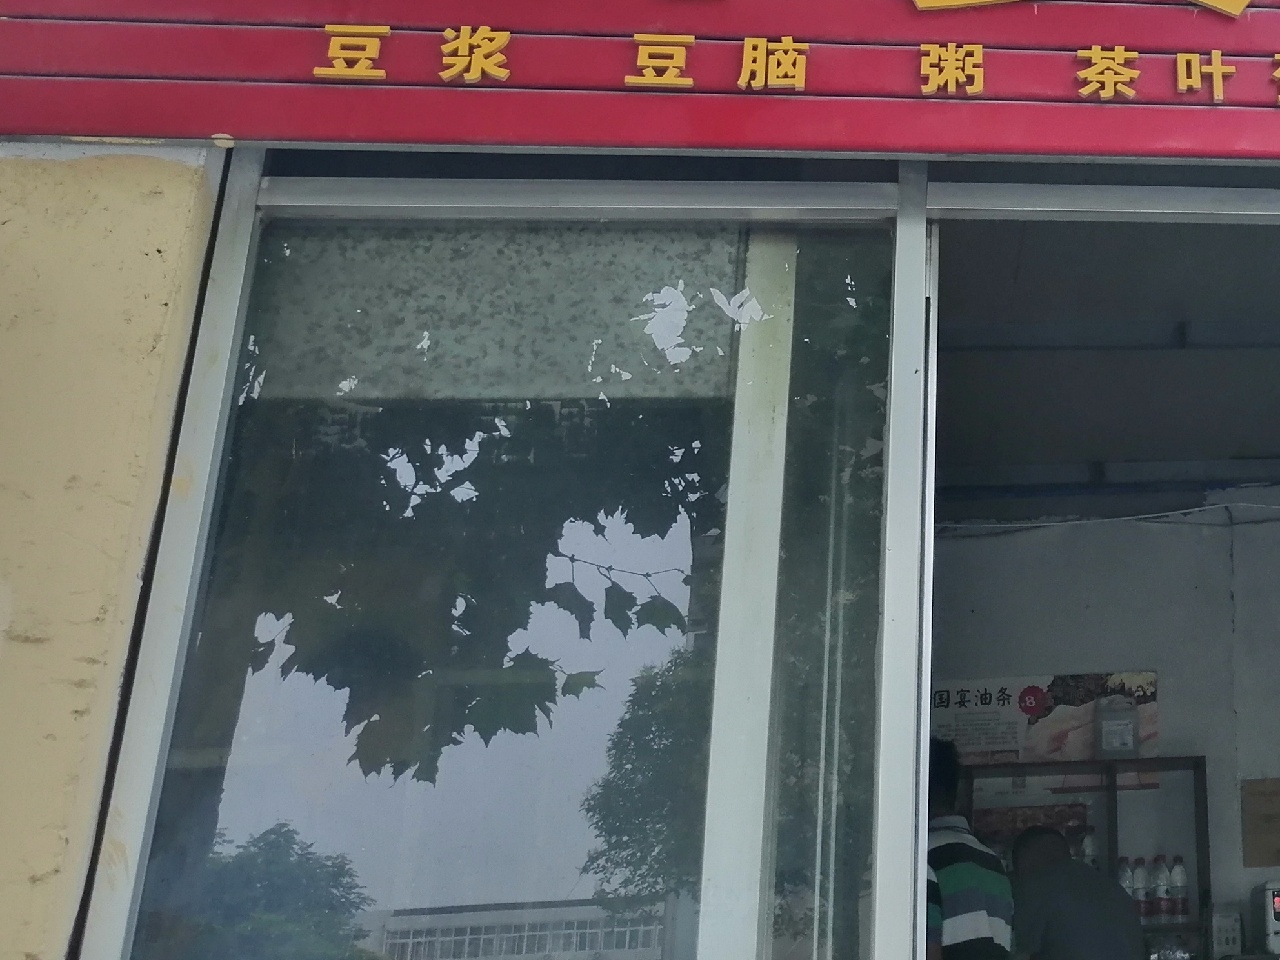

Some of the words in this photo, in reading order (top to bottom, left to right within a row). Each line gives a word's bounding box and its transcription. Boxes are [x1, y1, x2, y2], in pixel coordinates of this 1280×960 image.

[312, 24, 511, 83] 豆浆
[624, 33, 809, 91] 豆脑
[920, 42, 984, 97] 粥
[933, 686, 1013, 709] 国宴油条
